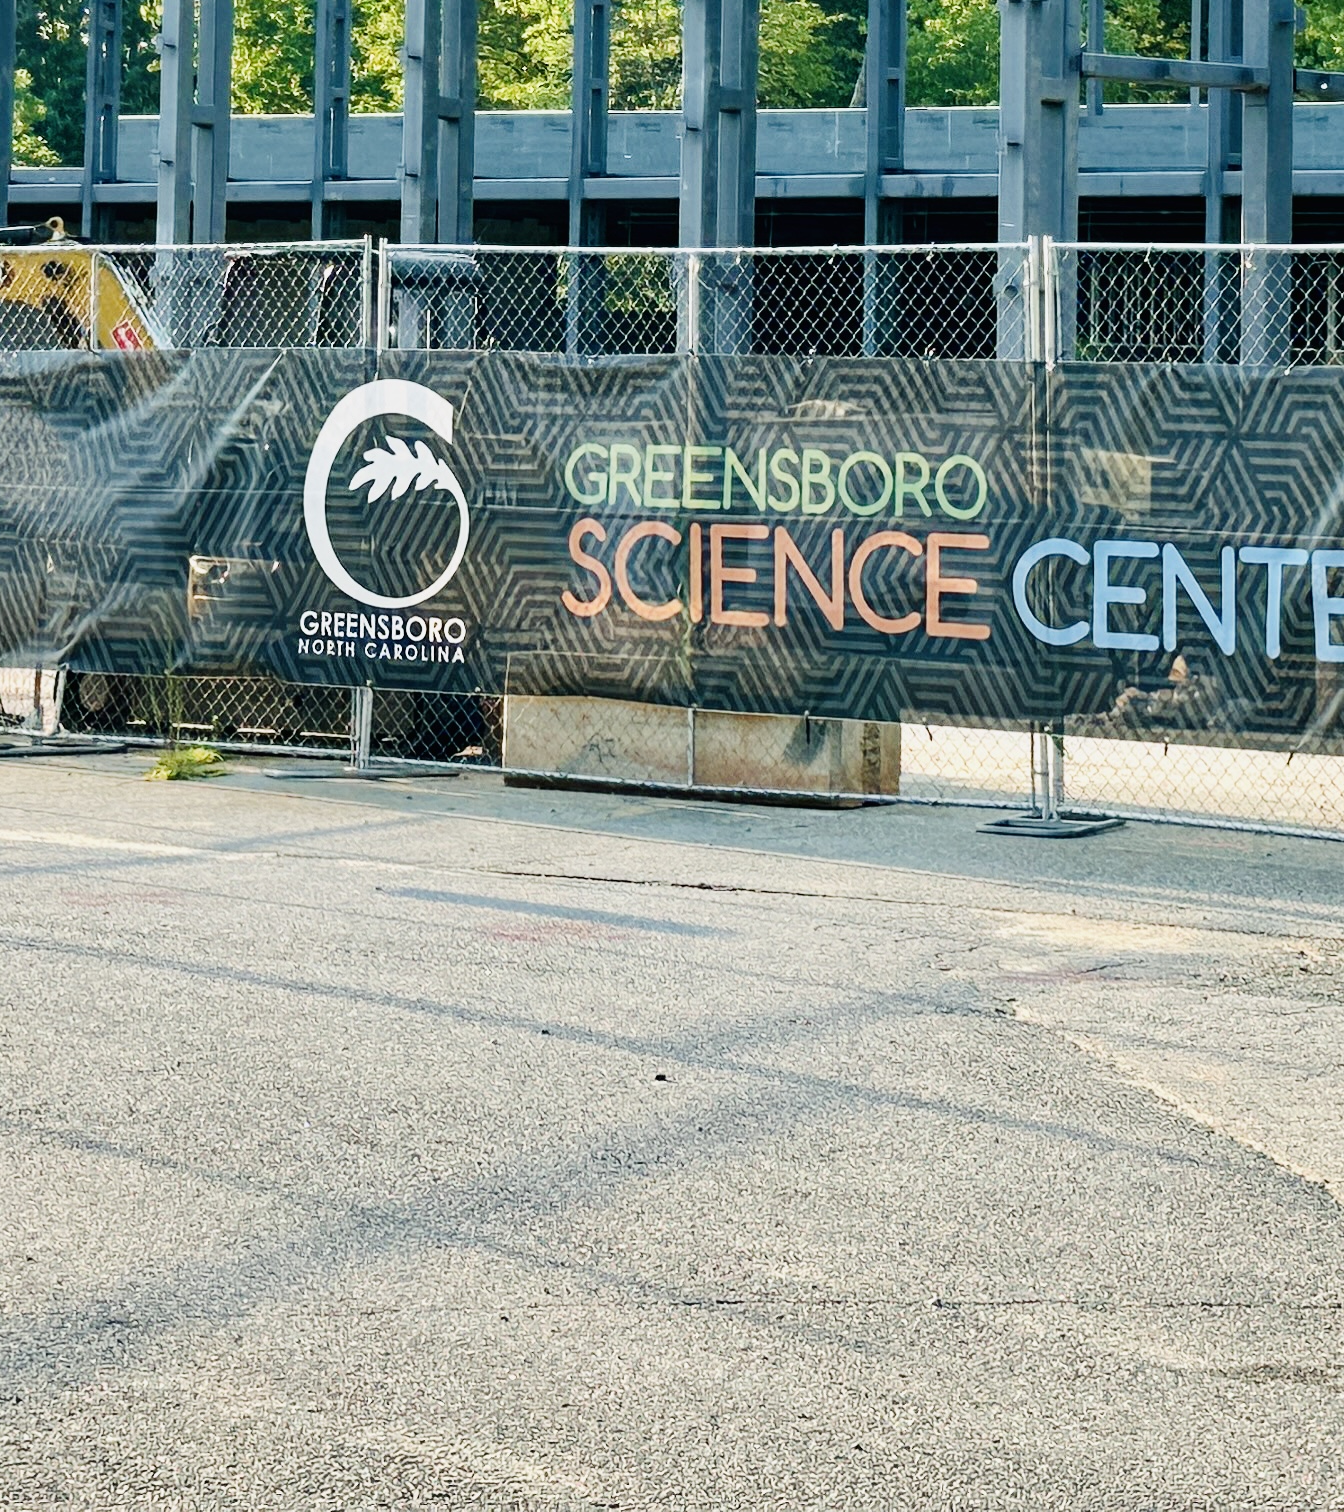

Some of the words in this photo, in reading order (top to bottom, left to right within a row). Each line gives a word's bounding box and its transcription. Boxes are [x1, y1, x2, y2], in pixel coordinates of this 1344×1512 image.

[564, 442, 988, 520] GREENSBORO
[563, 516, 990, 639] SCIENCE
[297, 638, 355, 658] NORTH
[364, 642, 465, 664] CAROLINA
[299, 610, 467, 644] GREENSBORO
